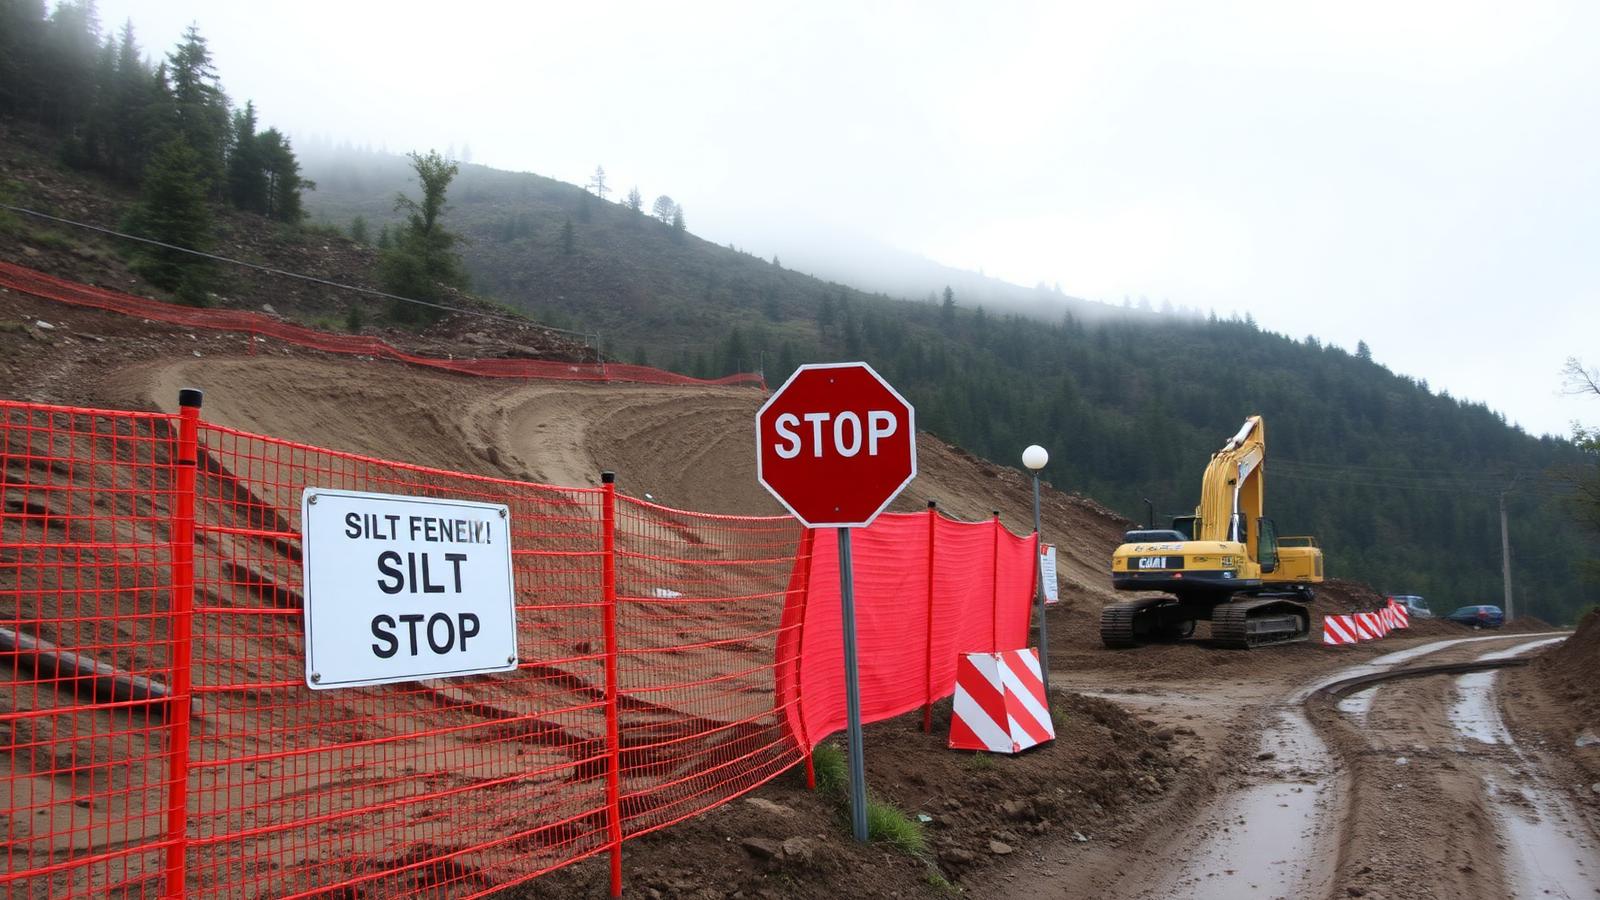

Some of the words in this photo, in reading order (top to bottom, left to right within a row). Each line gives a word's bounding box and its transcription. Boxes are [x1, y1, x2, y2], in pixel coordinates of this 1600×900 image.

[775, 410, 897, 459] STOP
[345, 512, 400, 540] SILT
[377, 550, 467, 594] SILT
[371, 612, 480, 658] STOP
